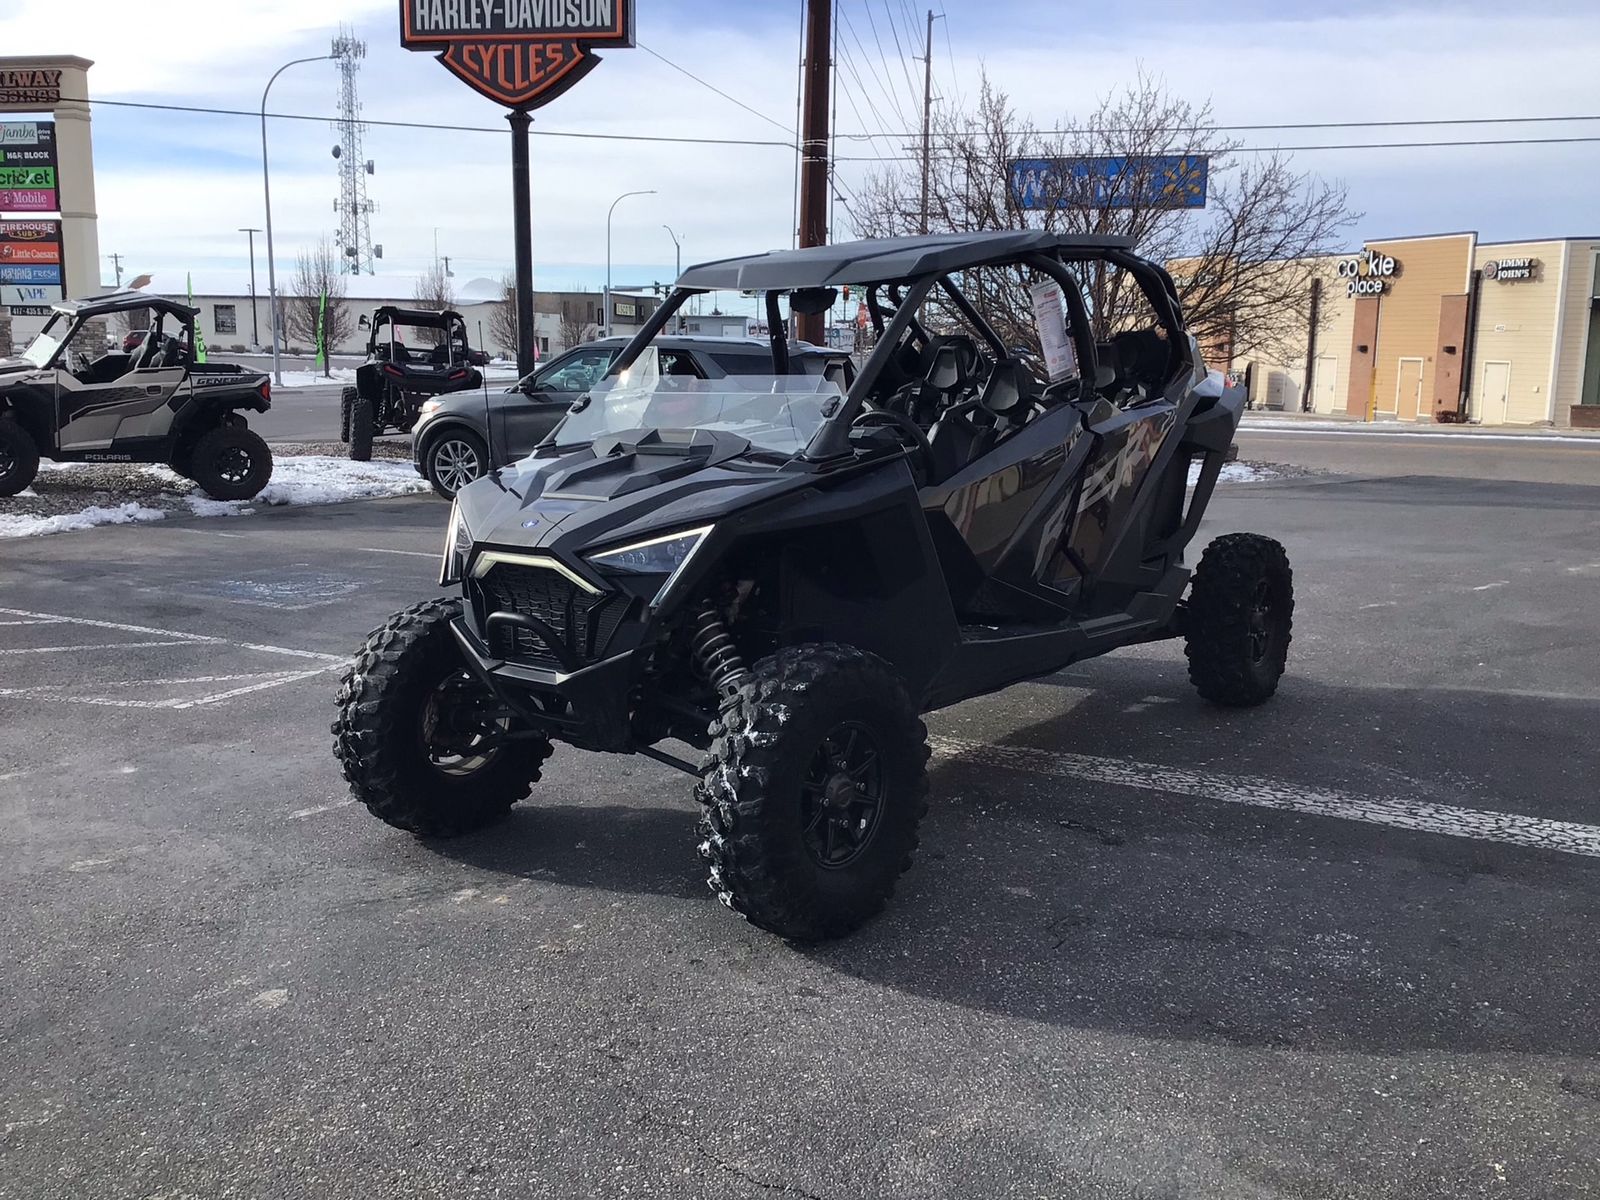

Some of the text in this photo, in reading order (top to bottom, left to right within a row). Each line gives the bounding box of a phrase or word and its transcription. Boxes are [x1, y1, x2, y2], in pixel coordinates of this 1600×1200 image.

[415, 0, 612, 31] HARLEY-DAVIDSON
[462, 43, 564, 91] CYCLES
[0, 70, 61, 88] LWAY
[1, 124, 36, 143] jamba
[7, 151, 49, 160] H&R BLOCK
[0, 170, 50, 185] cricket
[0, 223, 55, 234] FIREHOUSE
[12, 249, 58, 259] Little Caesars
[1337, 250, 1395, 278] cookie
[1498, 258, 1530, 270] JIMMY
[1497, 269, 1530, 281] JOHN'S
[1347, 276, 1383, 297] place
[16, 287, 47, 302] VAPE
[84, 453, 131, 461] POLARIS
